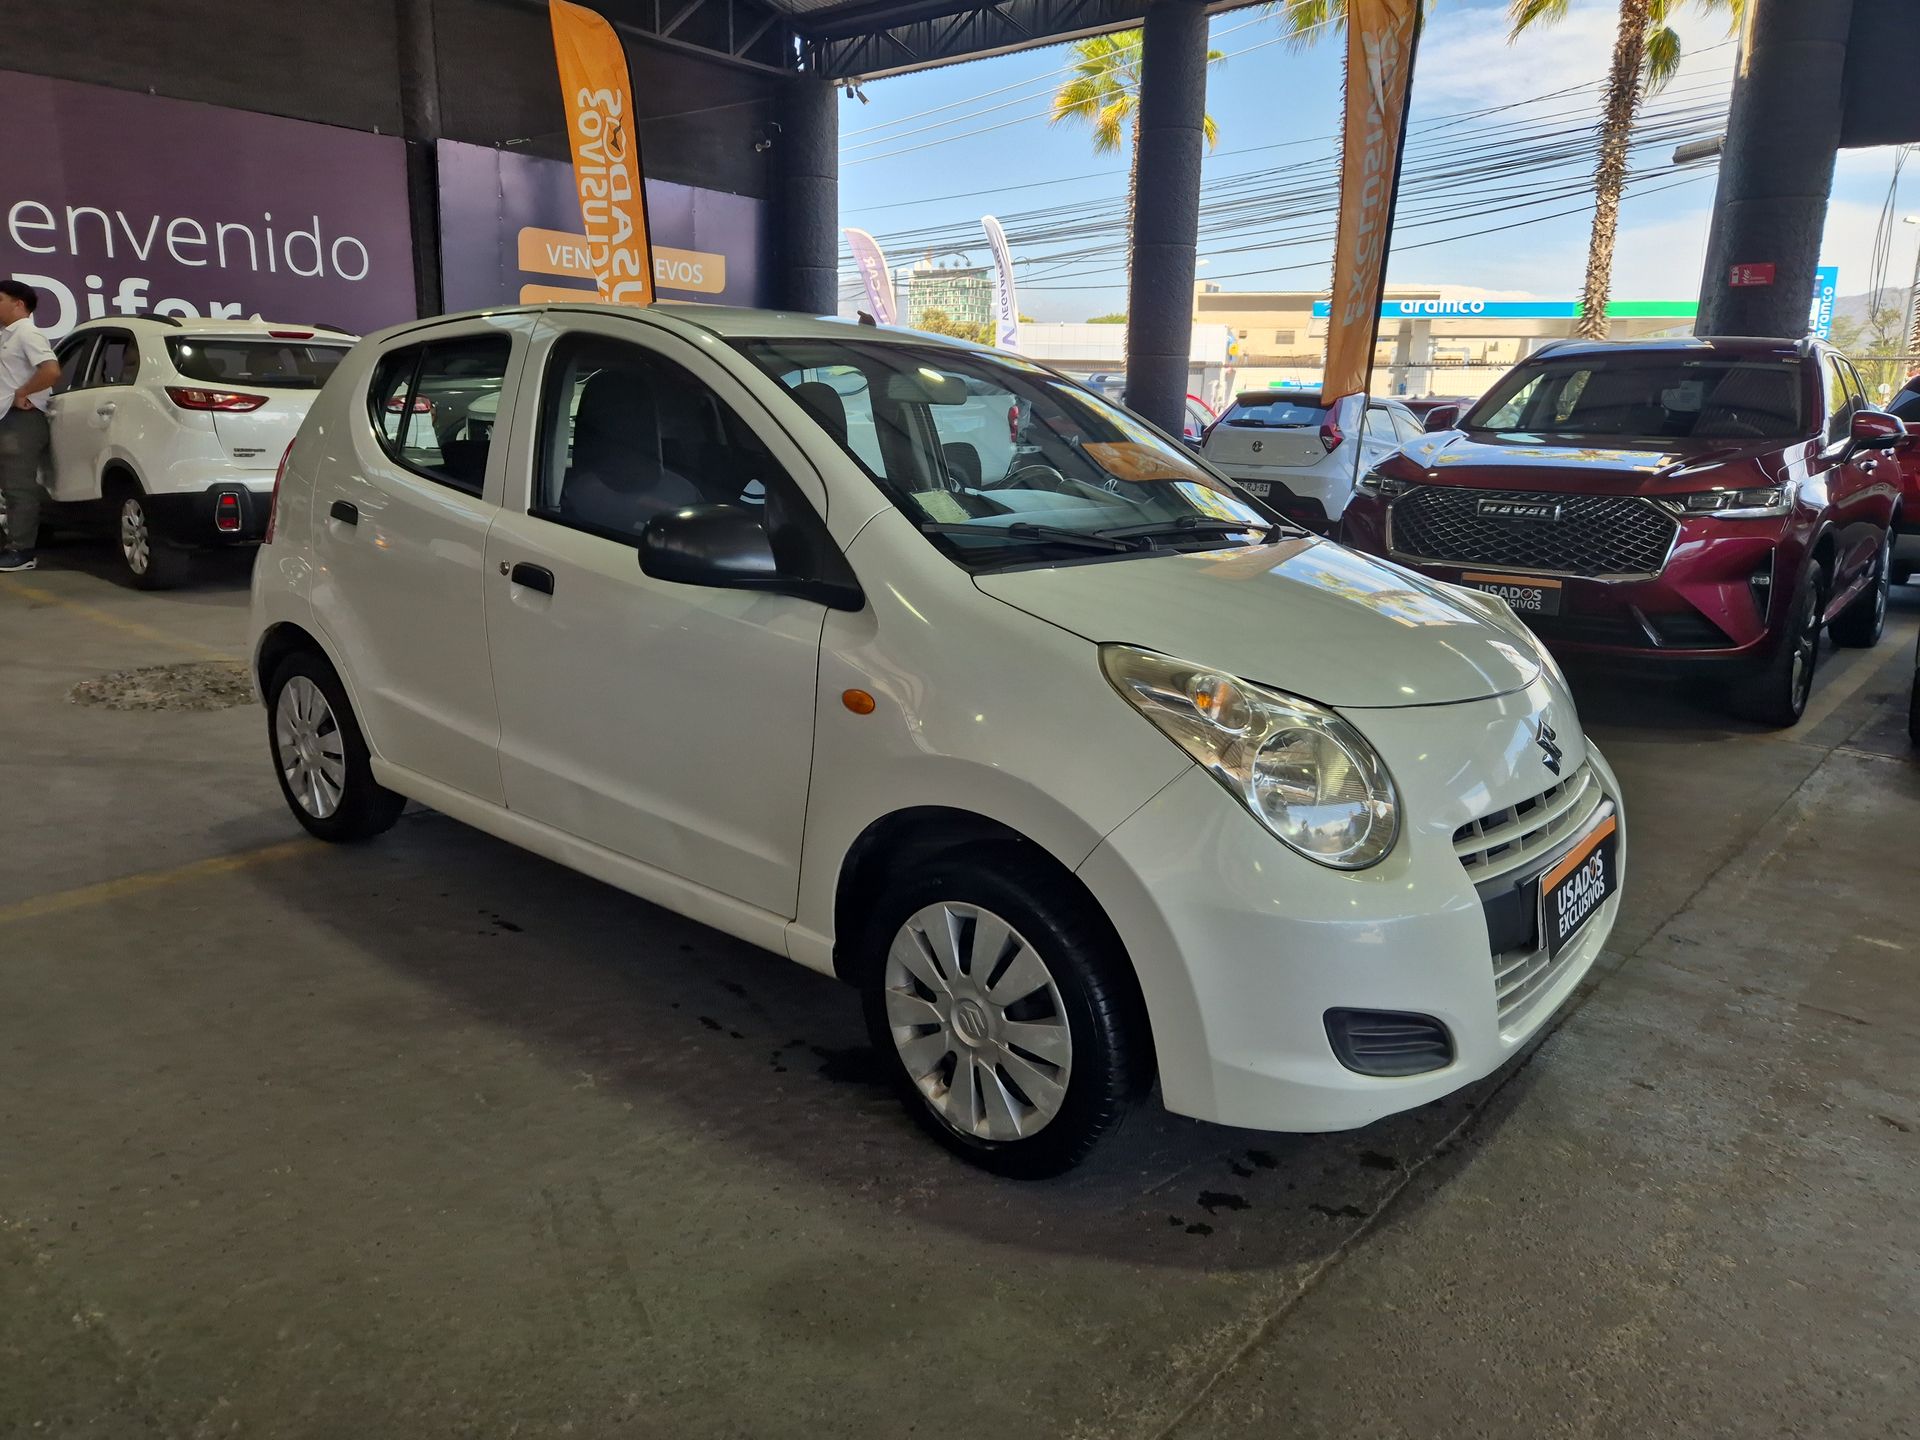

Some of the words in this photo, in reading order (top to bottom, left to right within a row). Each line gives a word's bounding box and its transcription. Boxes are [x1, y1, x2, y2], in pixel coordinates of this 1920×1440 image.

[8, 200, 369, 281] envenido
[1399, 299, 1485, 314] aramco
[1816, 286, 1834, 338] aramco
[1479, 584, 1542, 601] USADOS
[1557, 848, 1603, 915] USADOS
[1559, 875, 1605, 939] EXCLUSIVOS
